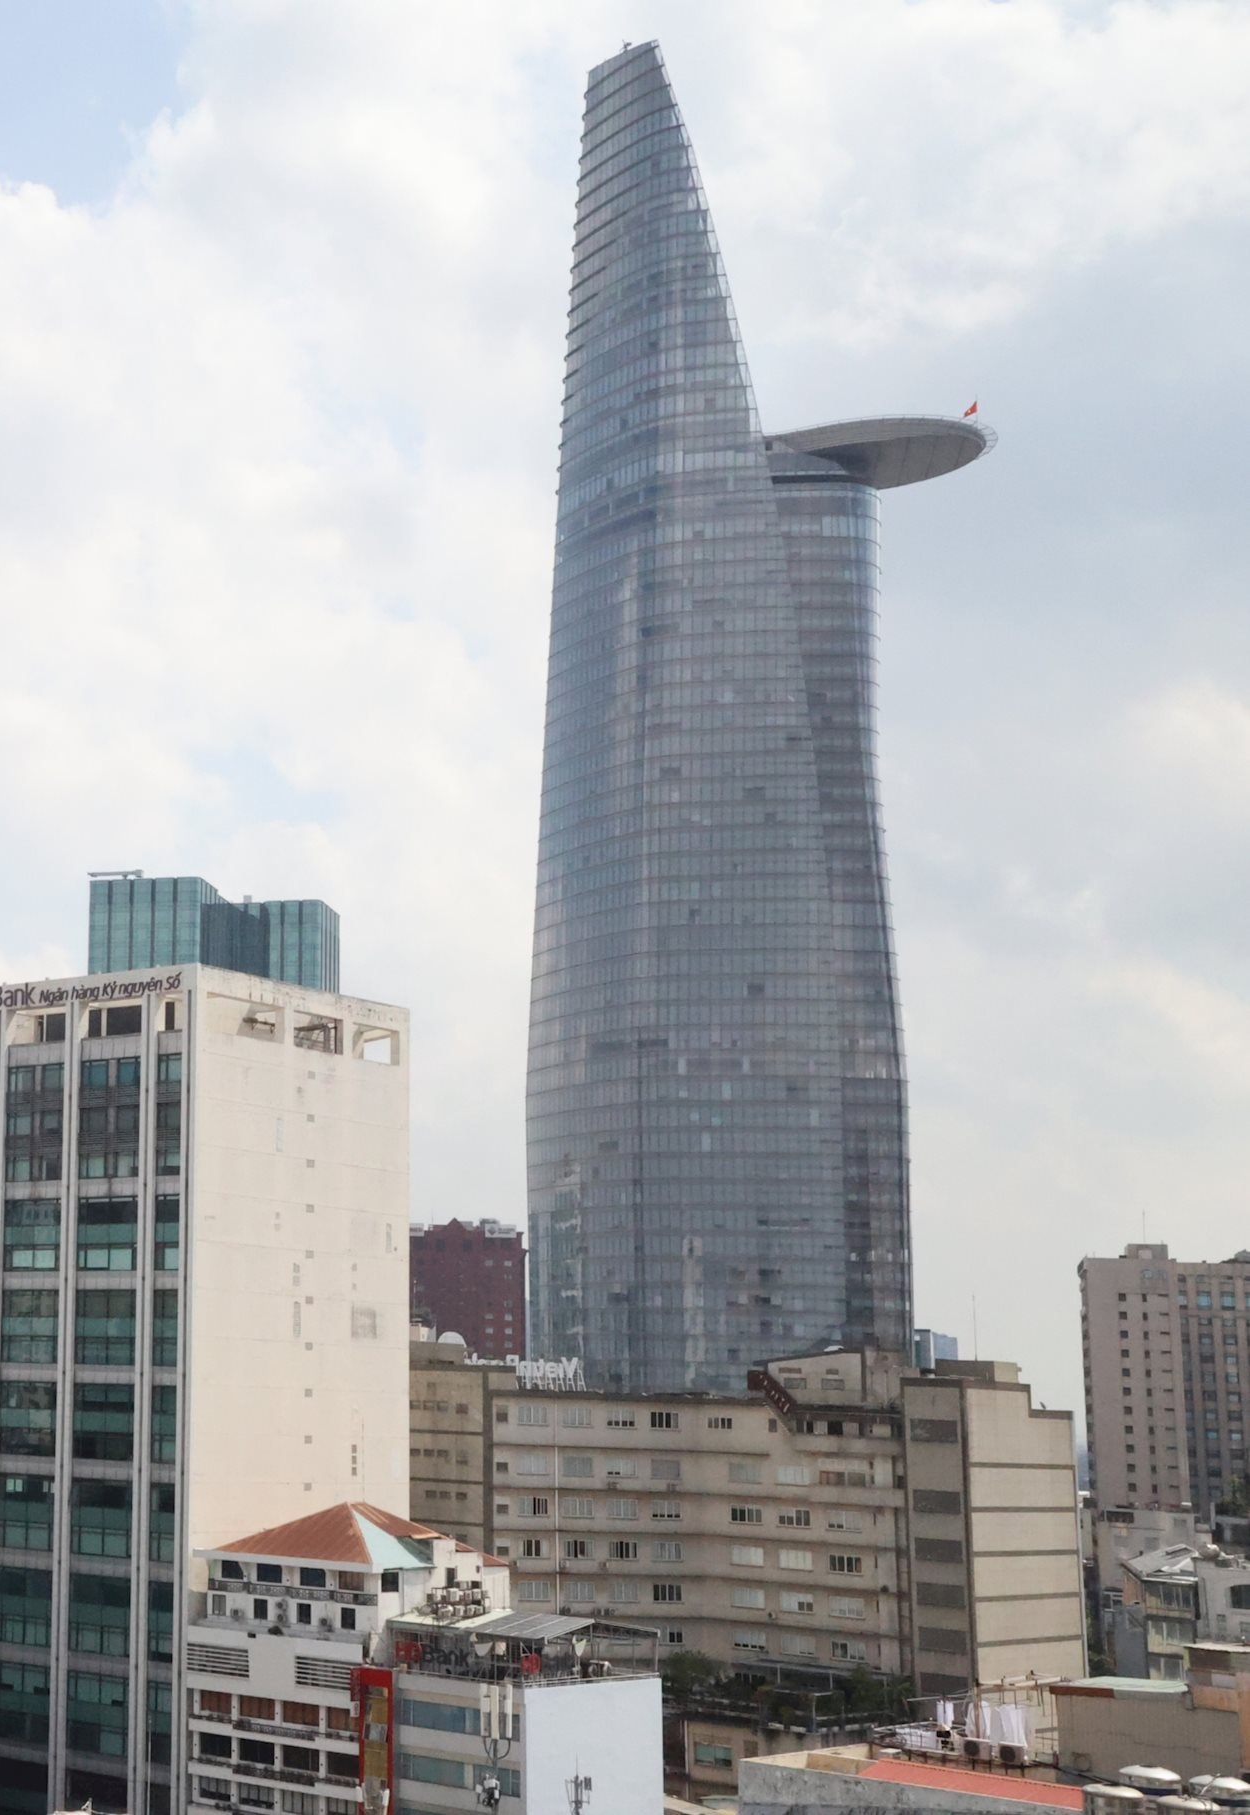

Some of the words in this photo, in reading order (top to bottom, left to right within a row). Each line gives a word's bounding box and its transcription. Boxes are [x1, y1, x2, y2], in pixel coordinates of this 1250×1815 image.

[39, 987, 69, 1005] Ngân
[71, 985, 100, 1000] hàng
[118, 976, 163, 997] nguyên
[165, 971, 182, 991] Số
